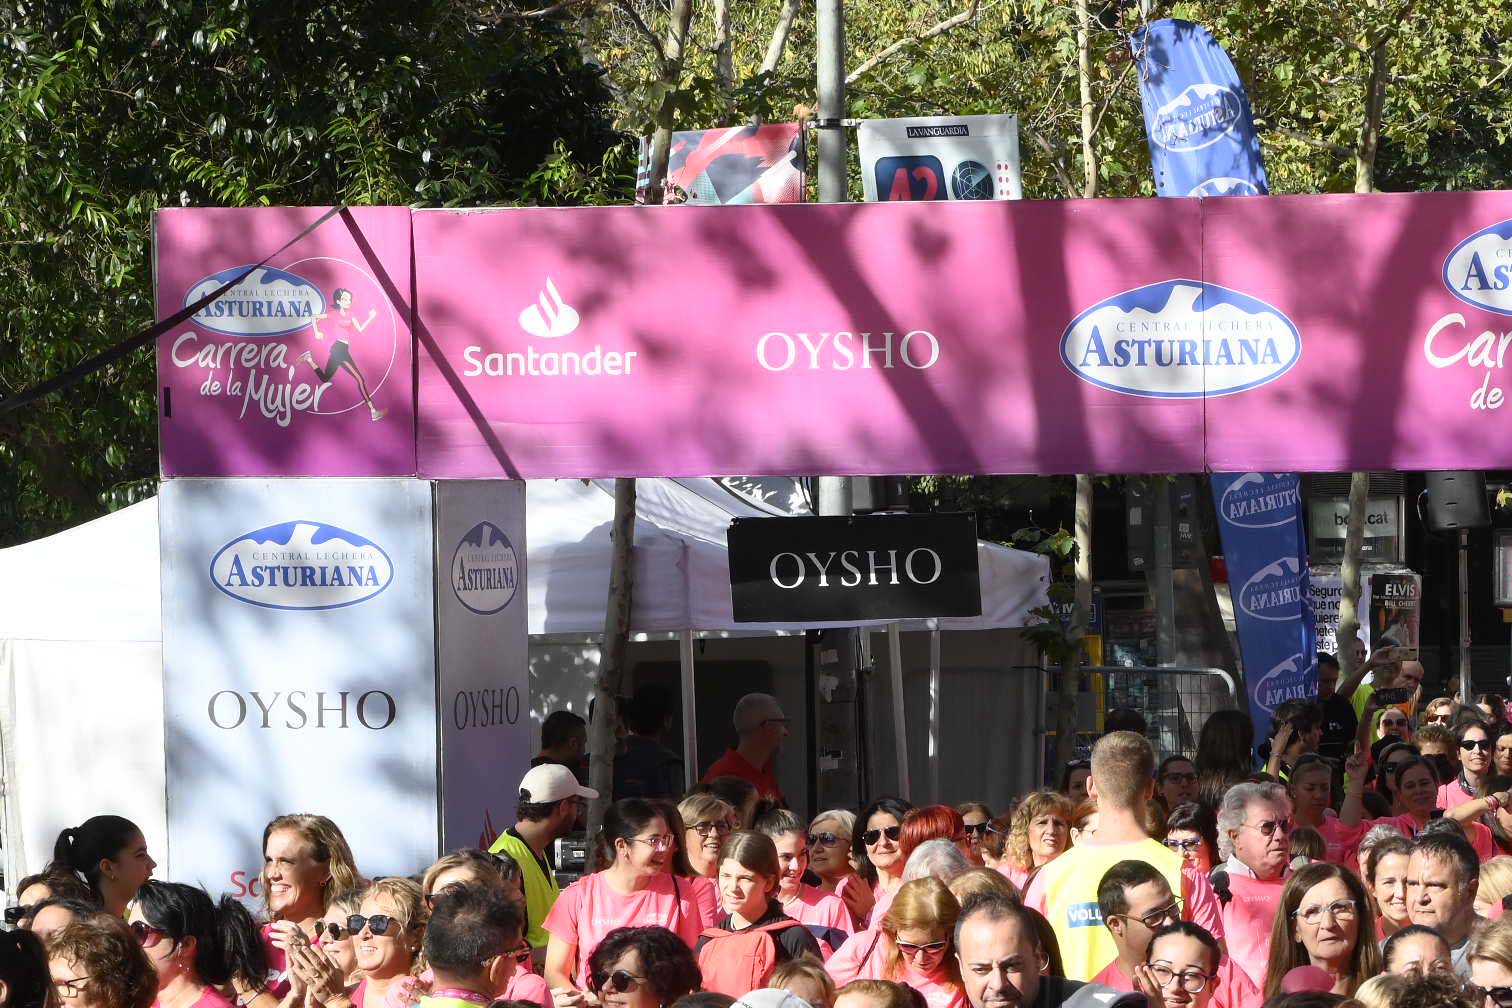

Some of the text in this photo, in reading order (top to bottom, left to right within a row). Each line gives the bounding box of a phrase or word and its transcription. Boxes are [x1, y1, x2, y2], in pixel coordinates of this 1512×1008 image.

[195, 291, 313, 318] ASTURIANA
[222, 289, 259, 297] ENTRAL
[171, 331, 288, 369] Carrera
[463, 345, 637, 377] Santander
[756, 329, 941, 373] OYSHO
[1079, 325, 1282, 369] ASTURIANA
[200, 365, 334, 428] de la Mujer
[1470, 372, 1504, 410] de
[224, 553, 381, 588] ASTURIANA
[252, 551, 375, 561] CENTRAL LECHERA
[769, 547, 942, 589] OYSHO
[456, 565, 515, 593] ASTURIANA
[1385, 583, 1416, 596] ELVIS
[1316, 639, 1330, 650] ste
[207, 690, 397, 731] OYSHO
[453, 684, 520, 732] OYSHO
